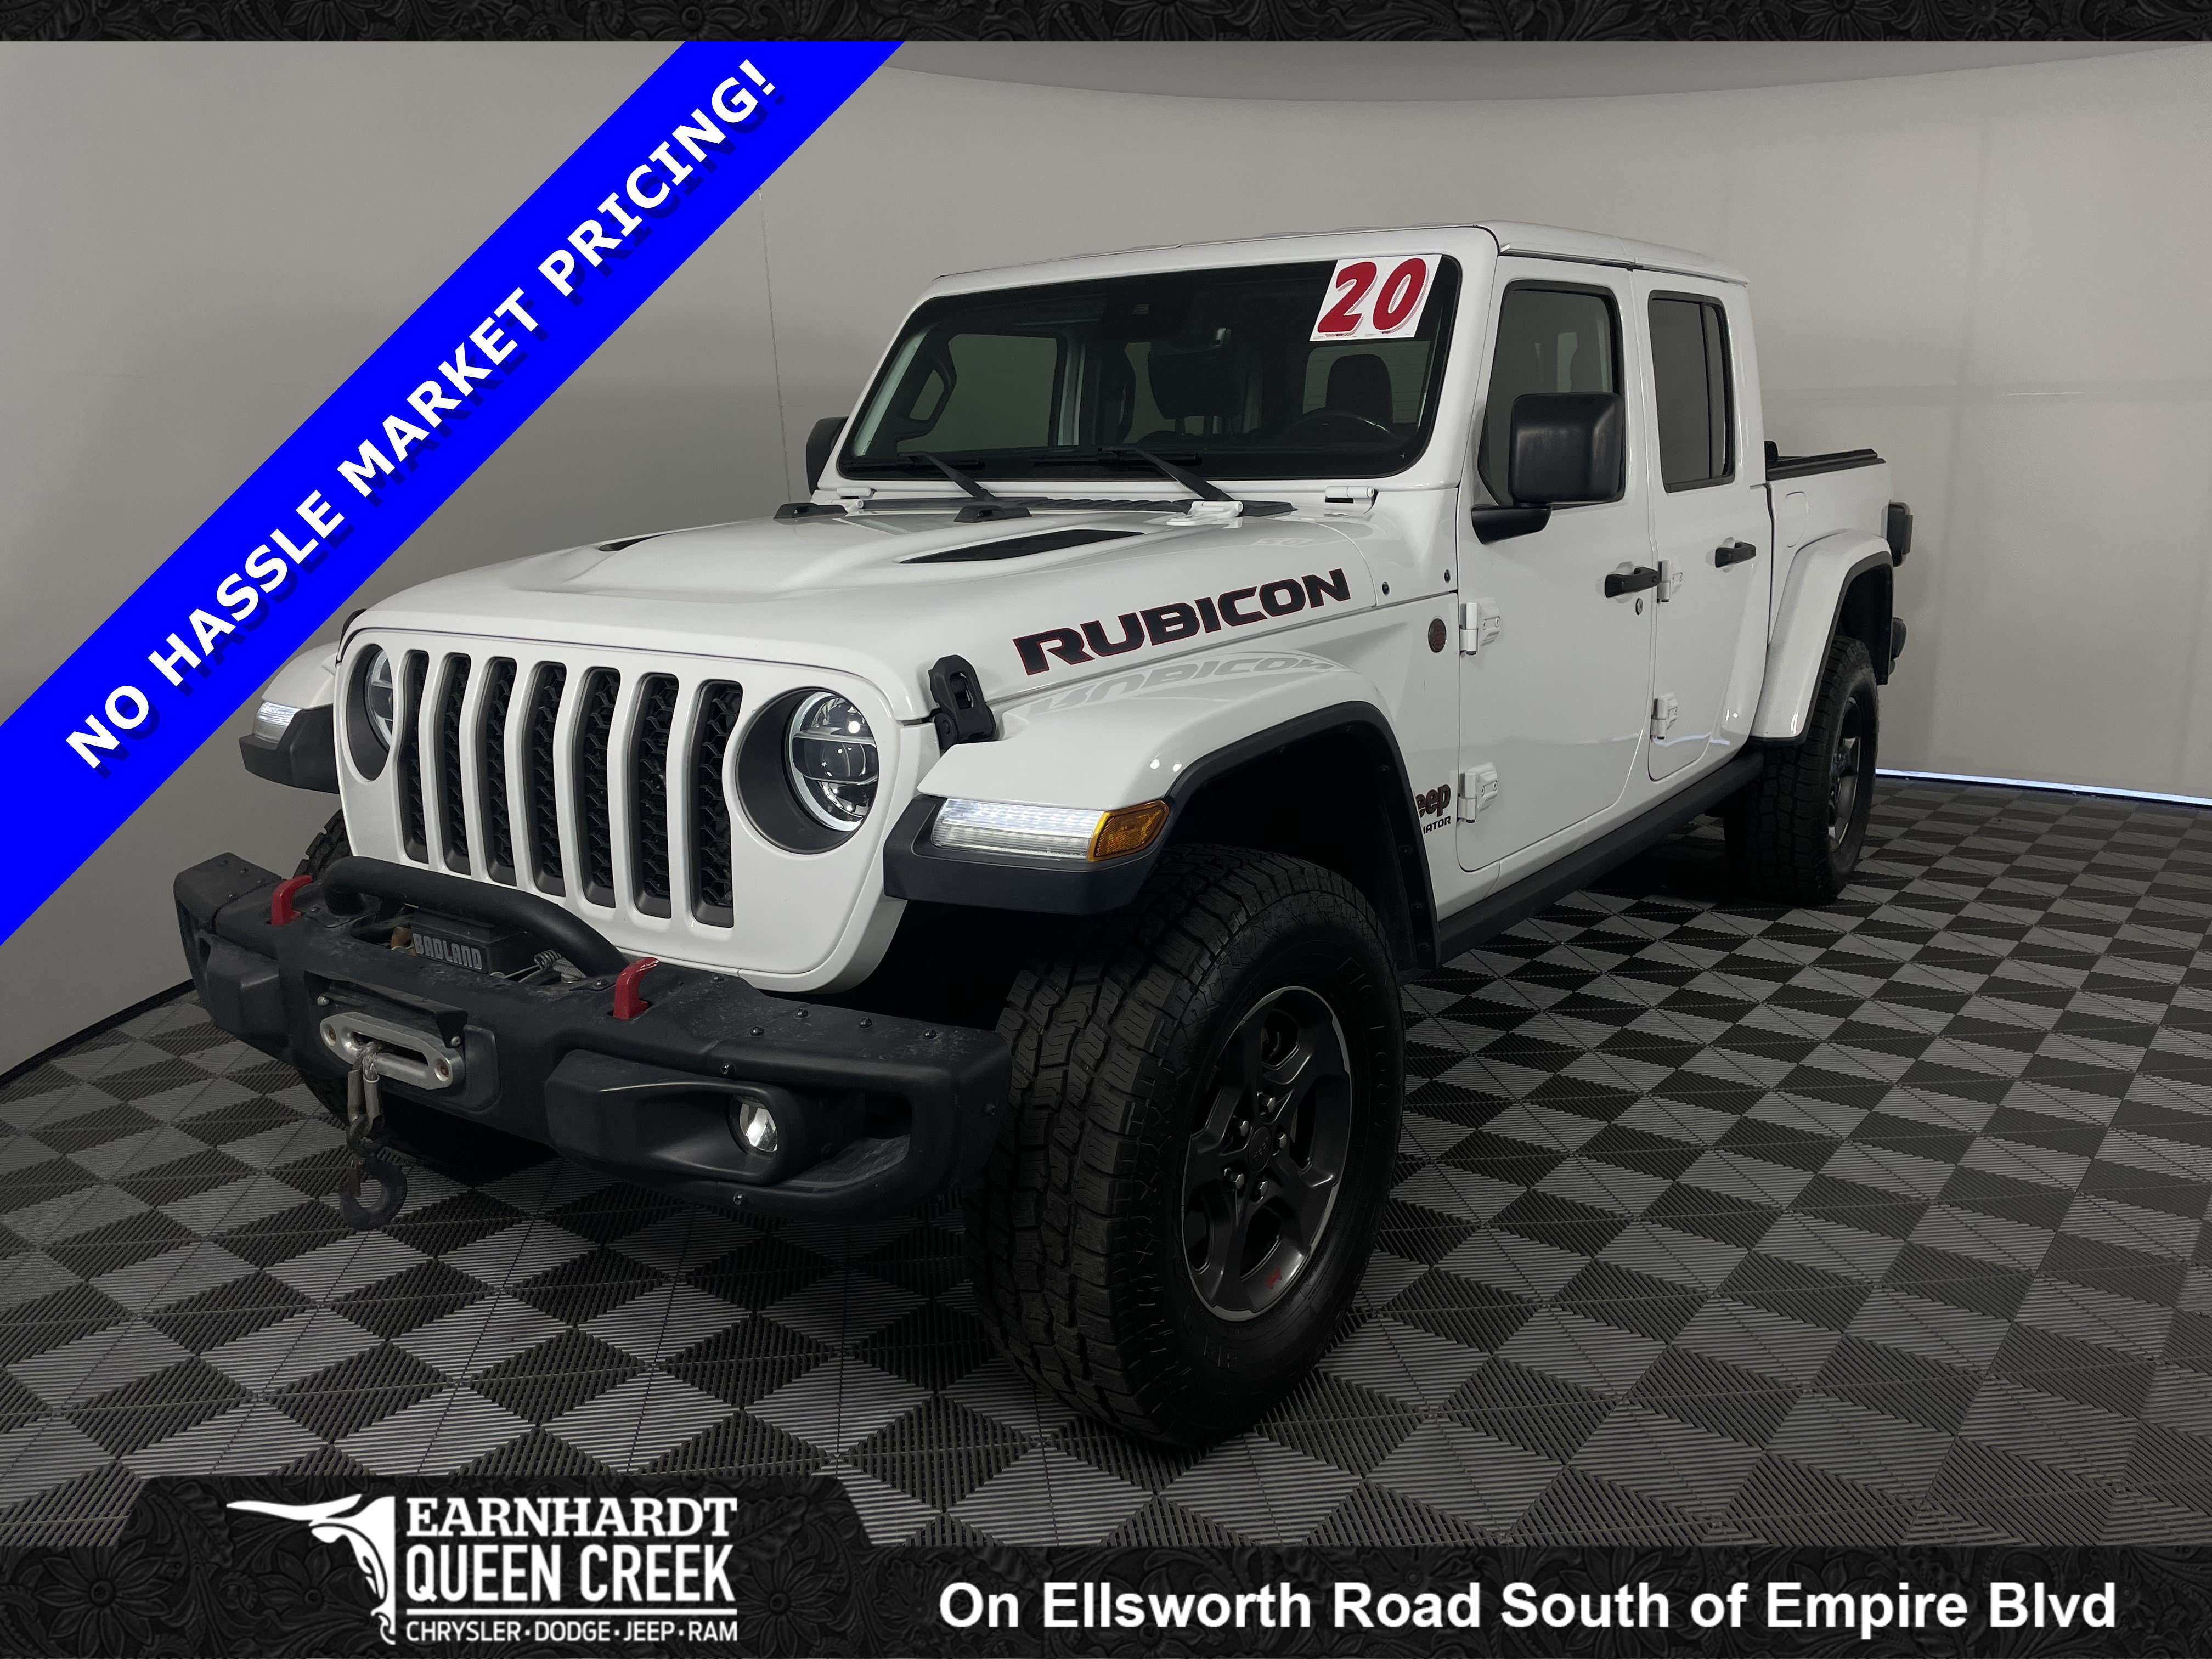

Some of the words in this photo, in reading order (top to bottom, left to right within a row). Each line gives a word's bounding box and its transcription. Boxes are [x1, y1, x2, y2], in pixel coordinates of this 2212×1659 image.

[1317, 258, 1429, 337] 20
[1013, 568, 1351, 676] RUBICON
[1415, 783, 1451, 818] eep
[1423, 816, 1451, 834] IATOR
[412, 933, 483, 970] BADLAND
